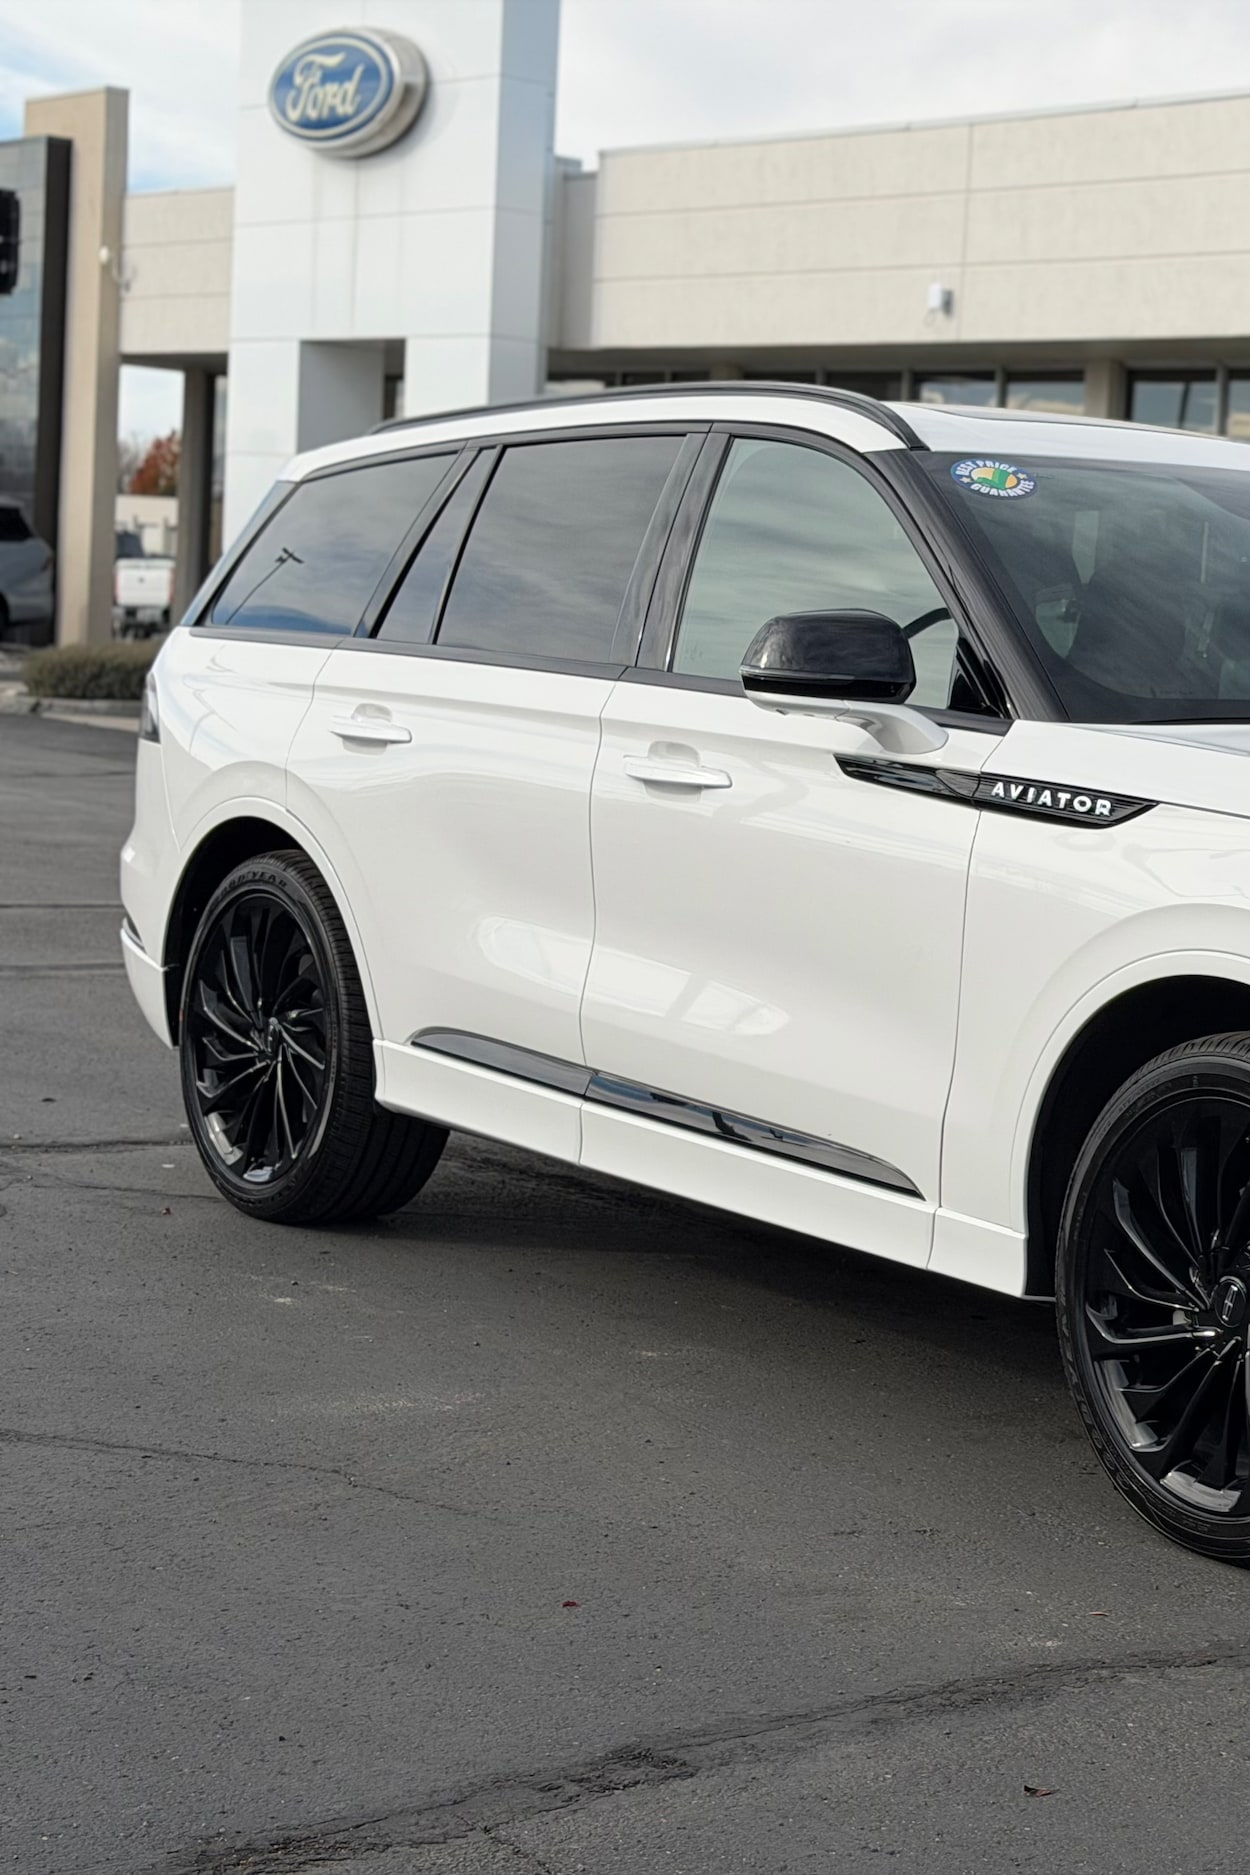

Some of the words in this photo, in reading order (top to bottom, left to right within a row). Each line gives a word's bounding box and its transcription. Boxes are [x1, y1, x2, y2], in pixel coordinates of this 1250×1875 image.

[285, 52, 366, 122] Ford
[955, 461, 977, 476] BEST
[976, 460, 1018, 473] PRICE
[969, 479, 1035, 497] GUARANTEE
[991, 781, 1112, 816] AVIATOR
